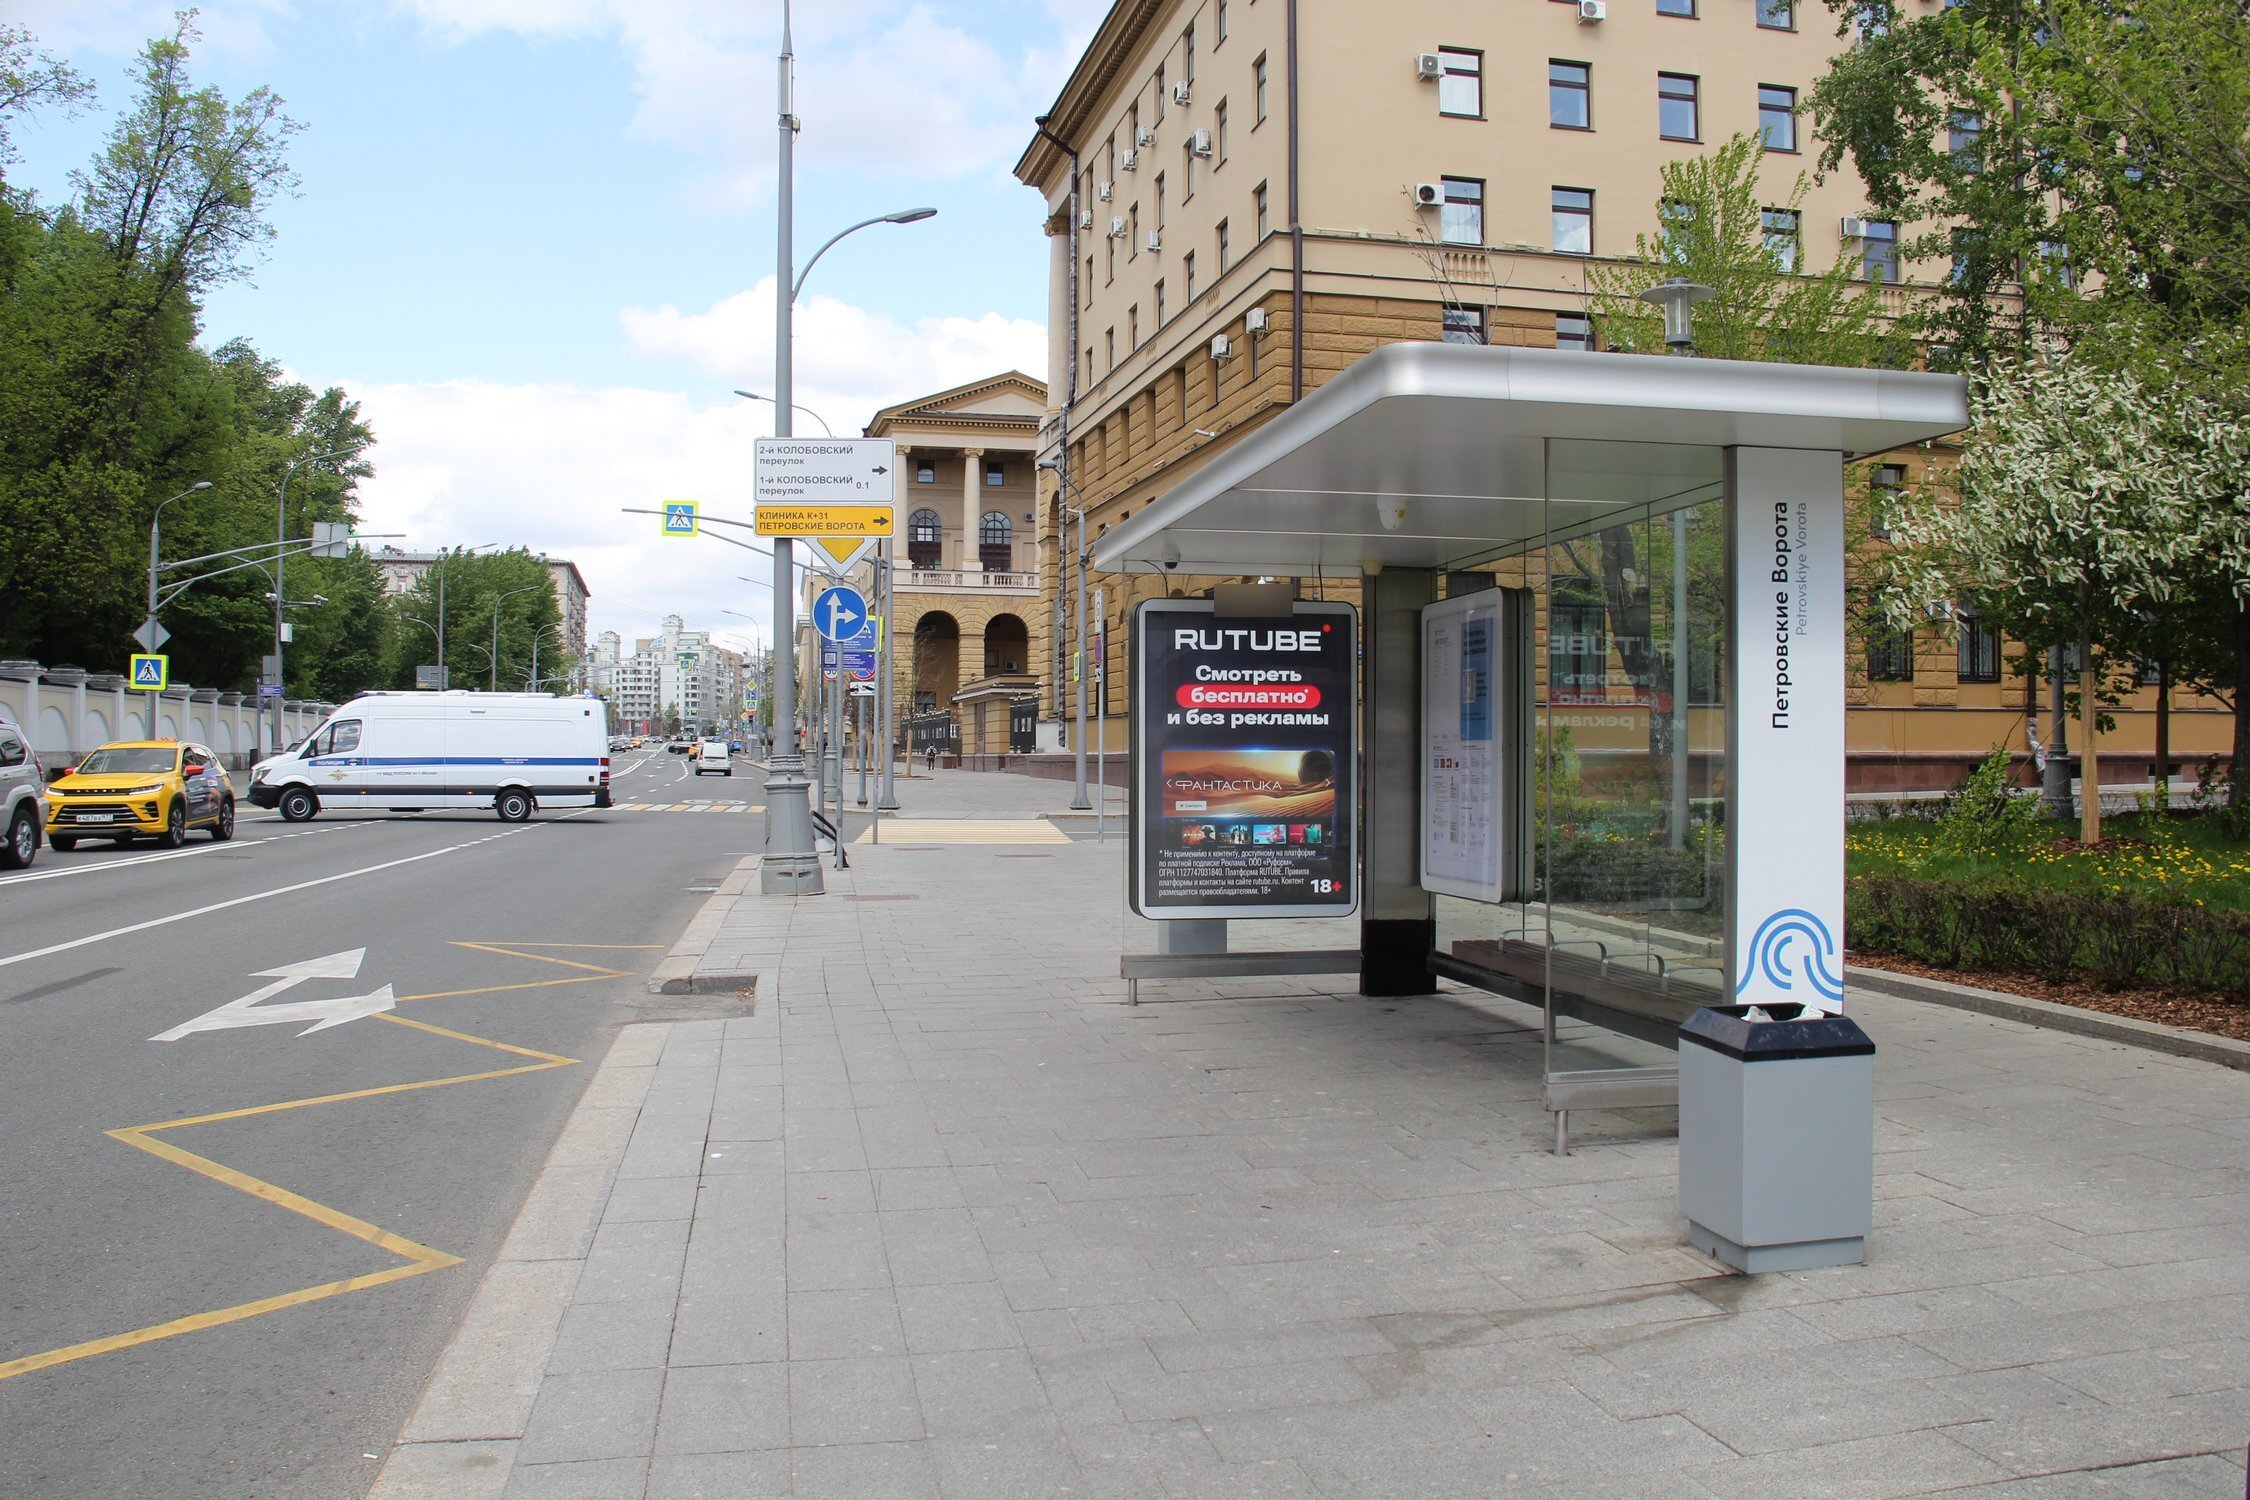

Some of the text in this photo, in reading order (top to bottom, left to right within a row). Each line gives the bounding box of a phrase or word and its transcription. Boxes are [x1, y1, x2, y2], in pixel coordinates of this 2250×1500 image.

[760, 445, 853, 455] 2-й КОЛОБОВСКИЙ
[760, 458, 804, 466] переулок
[760, 475, 853, 484] 1-й КОЛОБОВСКИЙ
[760, 488, 804, 496] переулок
[759, 512, 828, 520] КЛИНИКА К+31
[759, 522, 865, 530] ПЕТРОВСКИЕ ВОРОТА
[1796, 502, 1809, 636] Petrovskiye Vorota
[1771, 501, 1792, 729] Петровские Ворота
[1174, 629, 1321, 652] RUTUBE
[1195, 665, 1302, 685] Смотреть
[1167, 709, 1329, 728] и без рекламы
[1175, 780, 1283, 791] ФАНТАСТИКА
[1164, 849, 1172, 858] Не
[1173, 850, 1207, 859] применимо
[1241, 850, 1275, 858] доступному
[1284, 849, 1316, 858] платформе
[1248, 858, 1262, 866] ООО
[1159, 868, 1174, 877] ОГРН
[1225, 867, 1258, 877] Платформа
[1285, 867, 1309, 876] Правила
[1159, 878, 1192, 888] платформы
[1310, 879, 1342, 893] 18+
[1159, 889, 1198, 897] размещается
[1261, 886, 1271, 894] 18+
